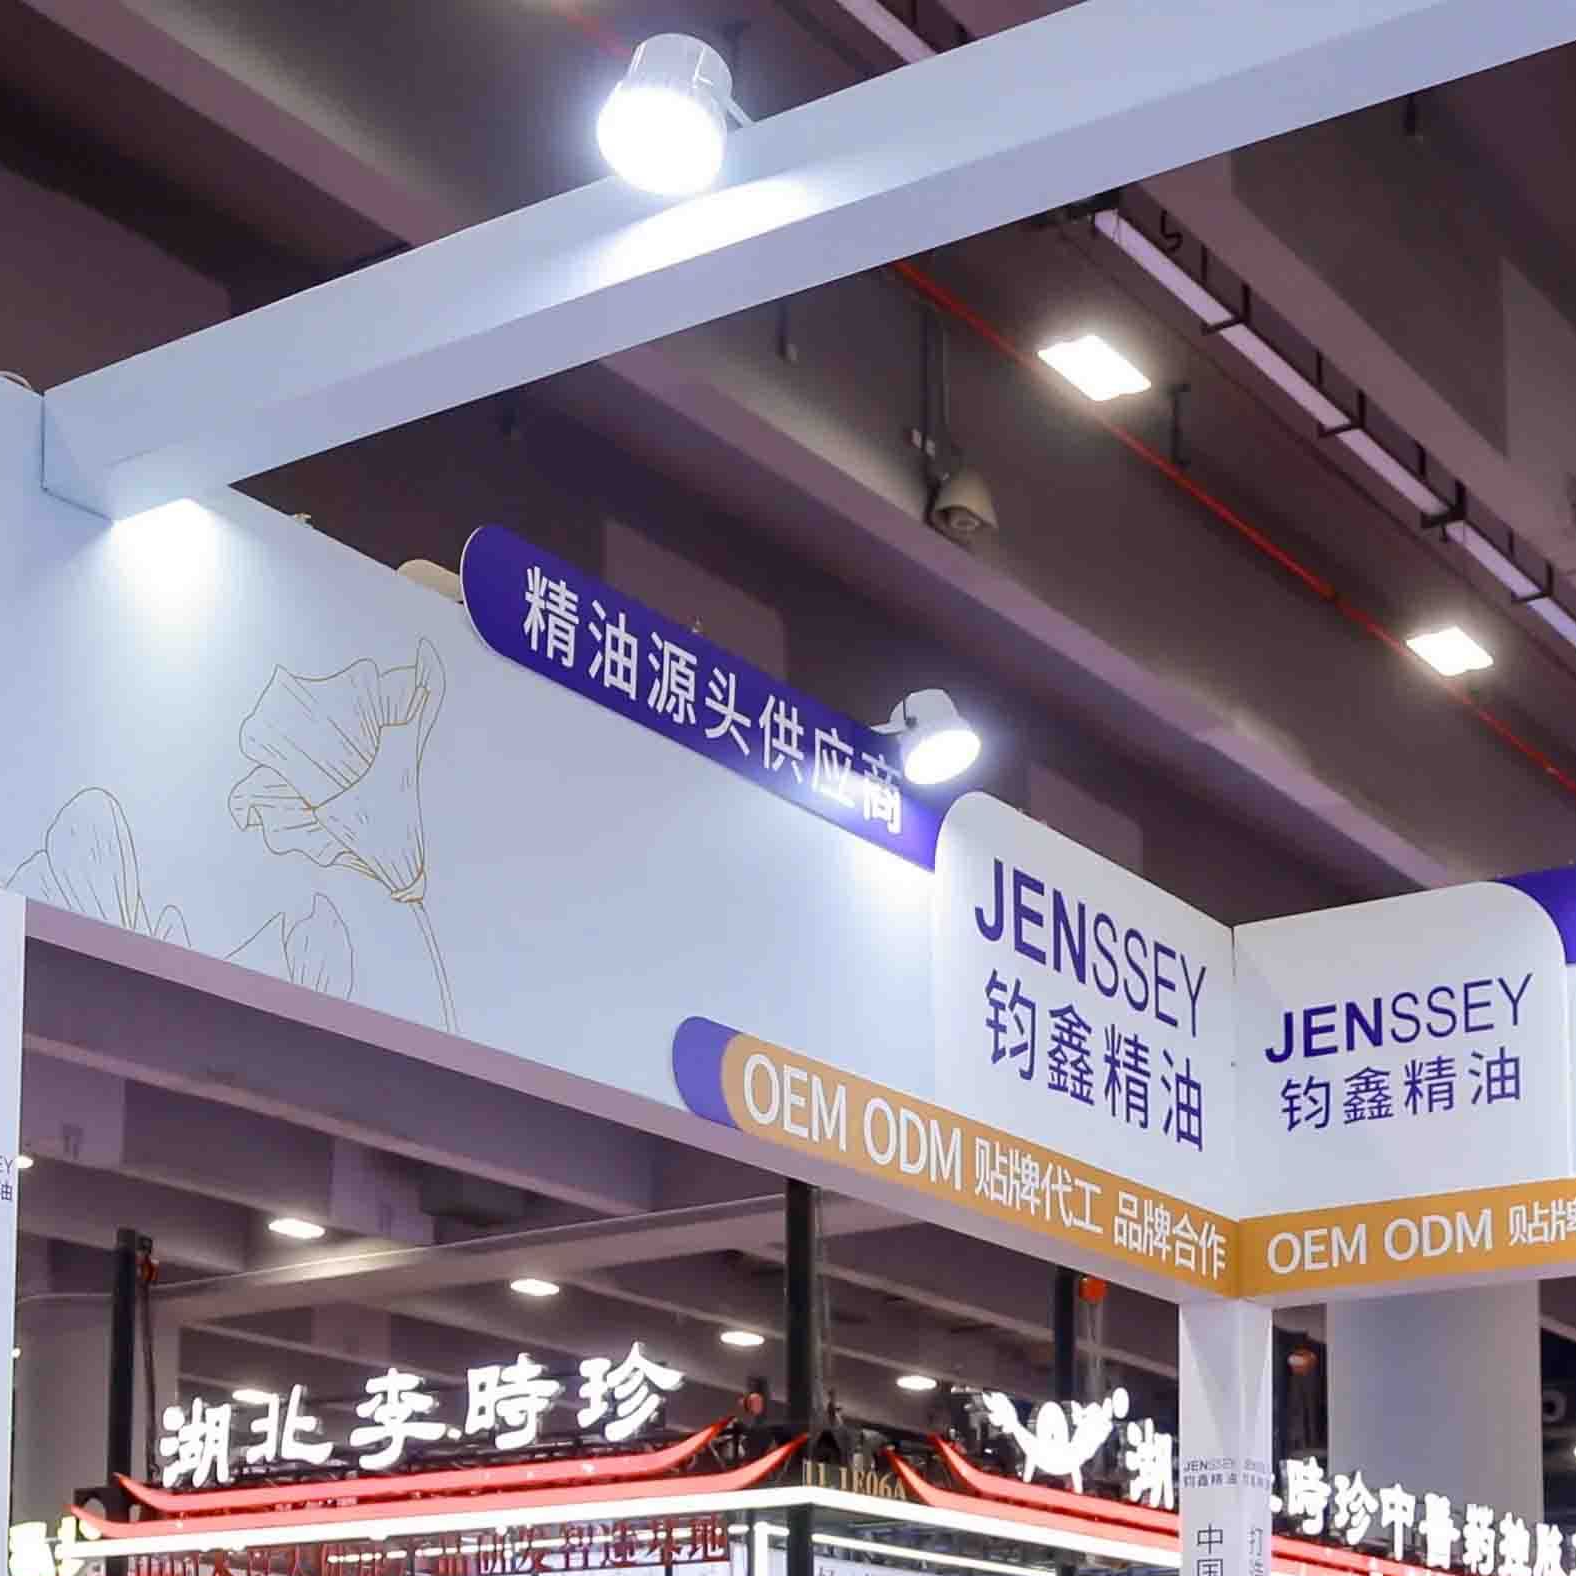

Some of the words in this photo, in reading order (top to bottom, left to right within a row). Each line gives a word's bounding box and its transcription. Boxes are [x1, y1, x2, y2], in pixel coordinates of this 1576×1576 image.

[522, 563, 905, 836] 精油源头供应商
[974, 856, 1209, 1041] JENSSEY
[1265, 972, 1534, 1066] JENSSEY
[984, 971, 1206, 1155] 钧鑫精油
[1280, 1045, 1523, 1133] 钧鑫精油
[742, 1052, 848, 1152] OEM
[861, 1108, 964, 1188] ODM
[973, 1143, 1104, 1240] 贴牌代工
[1112, 1200, 1228, 1283] 品牌合作
[1266, 1222, 1368, 1276] OEM
[1384, 1208, 1494, 1264] ODM
